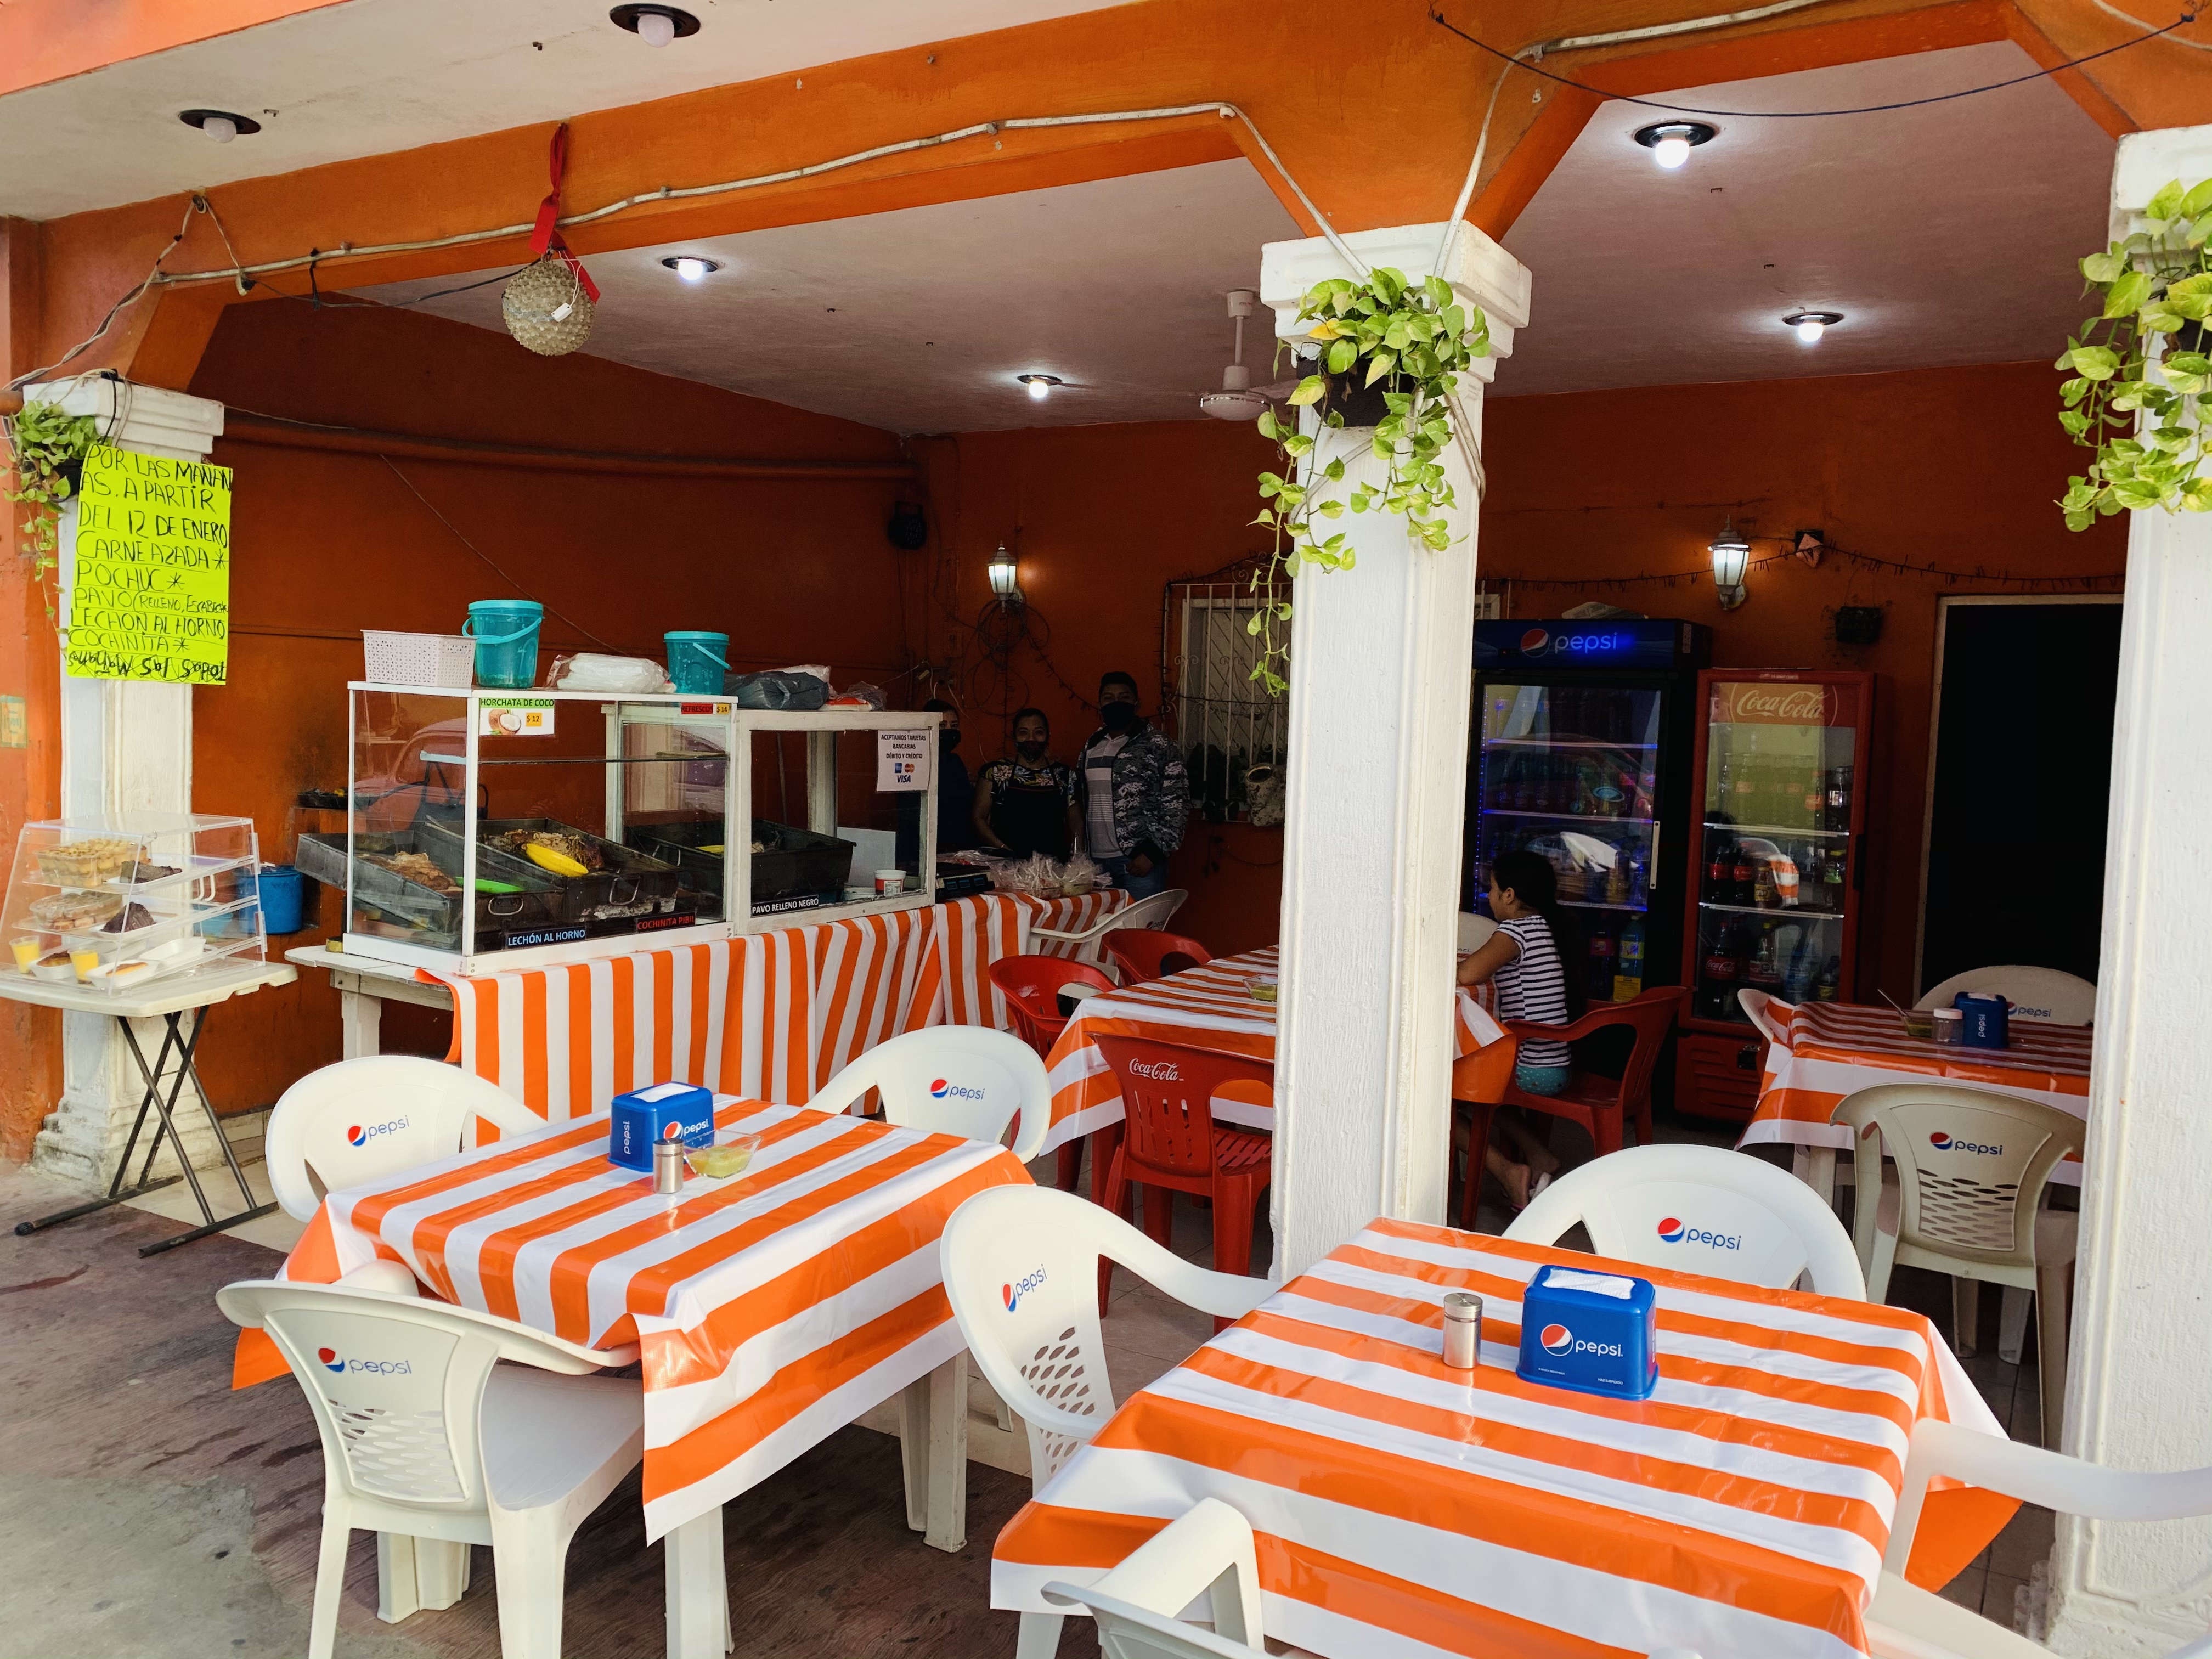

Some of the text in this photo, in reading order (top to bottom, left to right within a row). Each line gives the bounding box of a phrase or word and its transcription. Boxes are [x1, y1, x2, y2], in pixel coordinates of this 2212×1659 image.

[86, 444, 128, 472] POR
[135, 454, 170, 478] LAS
[124, 477, 138, 501] A
[79, 501, 228, 548] DEL 12 DE ENERO
[76, 530, 210, 569] CARNE AZADA
[76, 560, 164, 591] POCHUC
[74, 587, 132, 610] PAVO
[71, 608, 225, 640] LECHON AL HORNO
[1554, 631, 1617, 654] pepsi
[1736, 690, 1830, 718] Coca-Cola
[897, 775, 911, 783] VISA
[752, 898, 819, 914] PAVO RELLENO NEGRO
[637, 915, 695, 930] COCHINITA PIBIL
[508, 929, 585, 946] LECHÓN AL HORNO
[2018, 1007, 2052, 1017] pepsi
[1978, 1014, 1986, 1037] pepsi
[1129, 1058, 1180, 1081] Coca-Cola
[949, 1086, 985, 1101] pepsi
[368, 1115, 410, 1140] pepsi
[623, 1120, 631, 1155] pepsi
[684, 1119, 709, 1137] pepsi
[1955, 1141, 2003, 1155] pepsi
[1686, 1228, 1741, 1251] pepsi
[1015, 1263, 1047, 1302] pepsi
[1575, 1340, 1622, 1357] pepsi
[348, 1359, 412, 1376] pepsi
